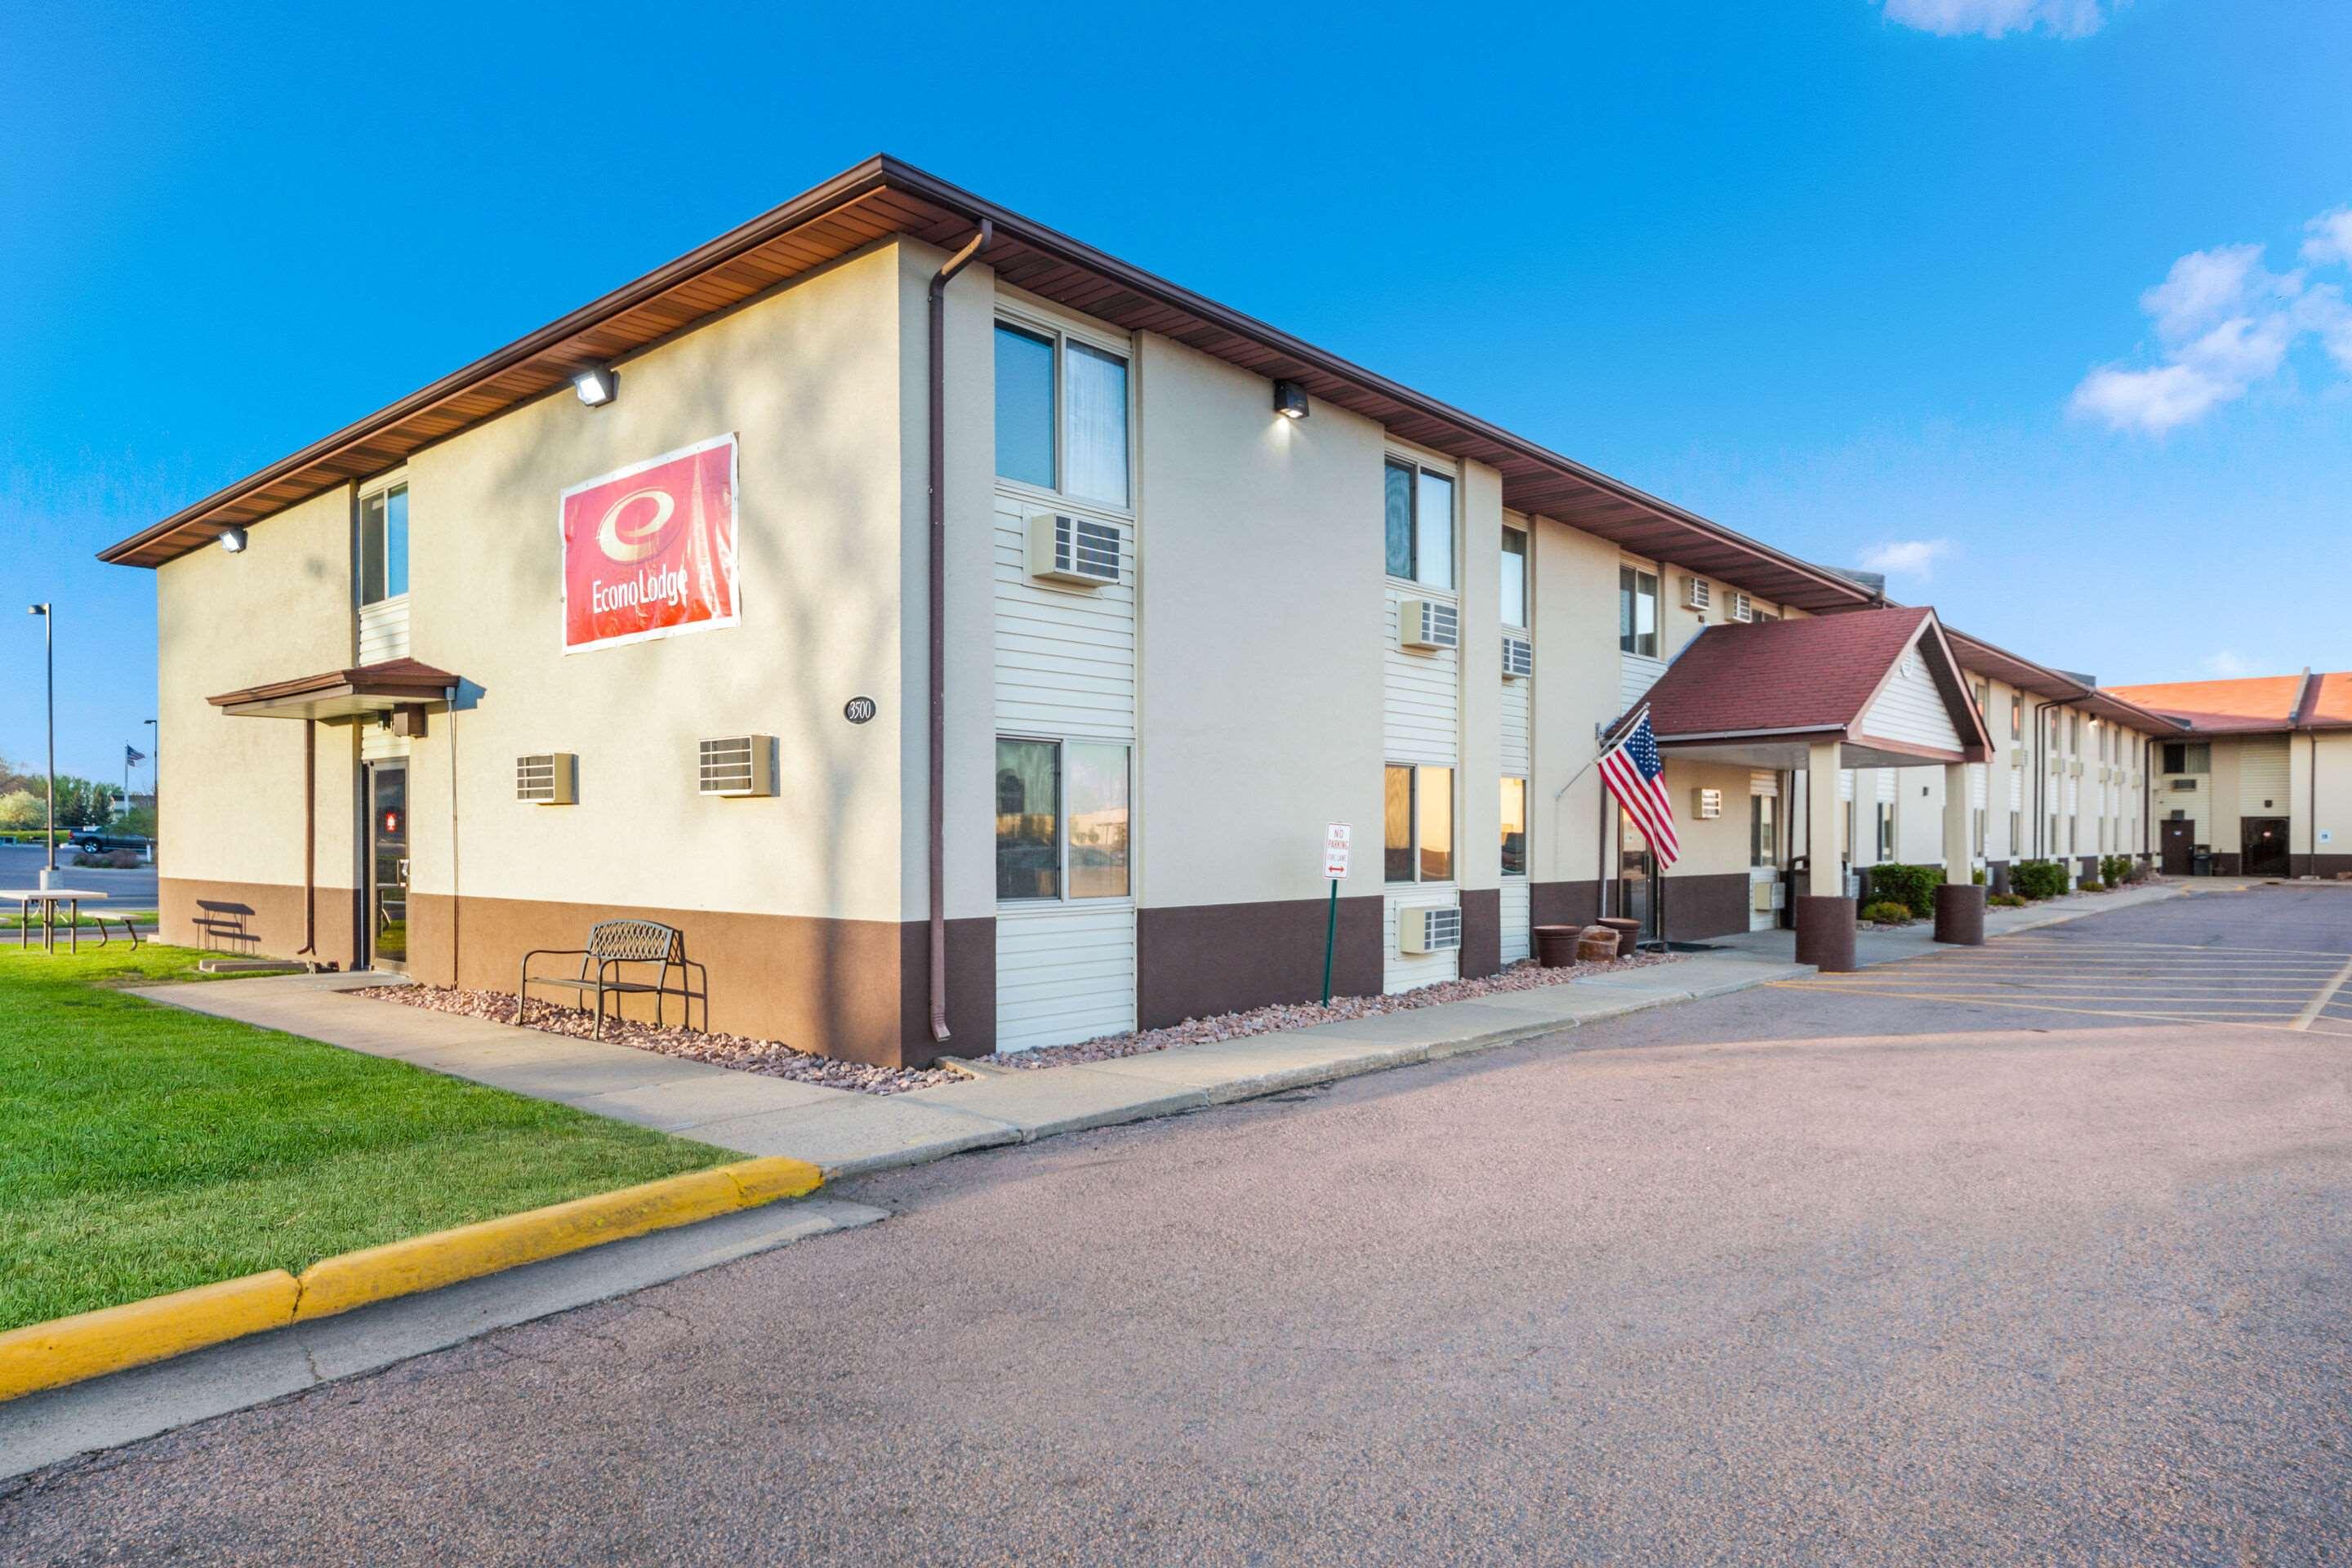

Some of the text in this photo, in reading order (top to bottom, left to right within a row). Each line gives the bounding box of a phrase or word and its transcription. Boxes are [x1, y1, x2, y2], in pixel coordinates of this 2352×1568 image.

[849, 701, 871, 719] 3500
[1334, 829, 1344, 839] NO
[1327, 839, 1348, 849] PARKING
